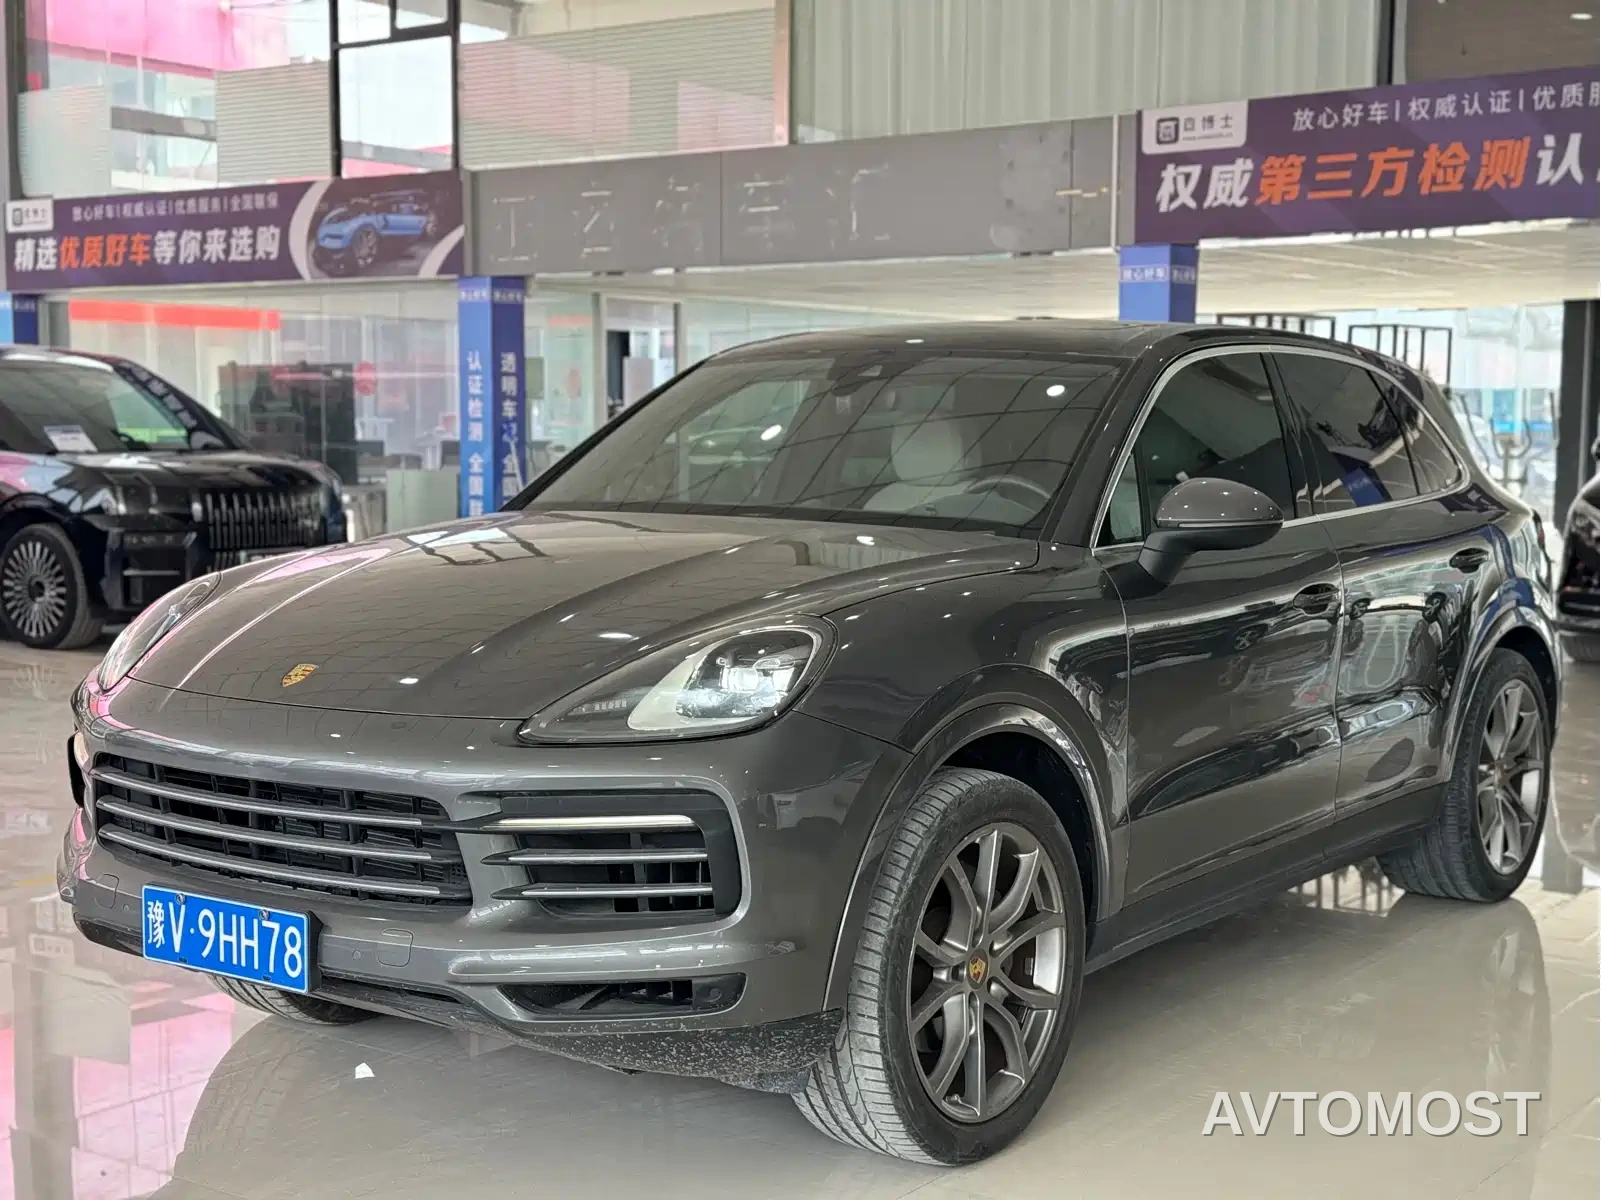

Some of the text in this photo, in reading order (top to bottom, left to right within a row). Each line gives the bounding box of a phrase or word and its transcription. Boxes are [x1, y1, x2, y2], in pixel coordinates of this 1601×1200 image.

[1155, 132, 1600, 213] 权威第三方检测认
[14, 224, 281, 271] 精选优质好车等你来选购
[147, 900, 302, 979] 豫V·9HH78
